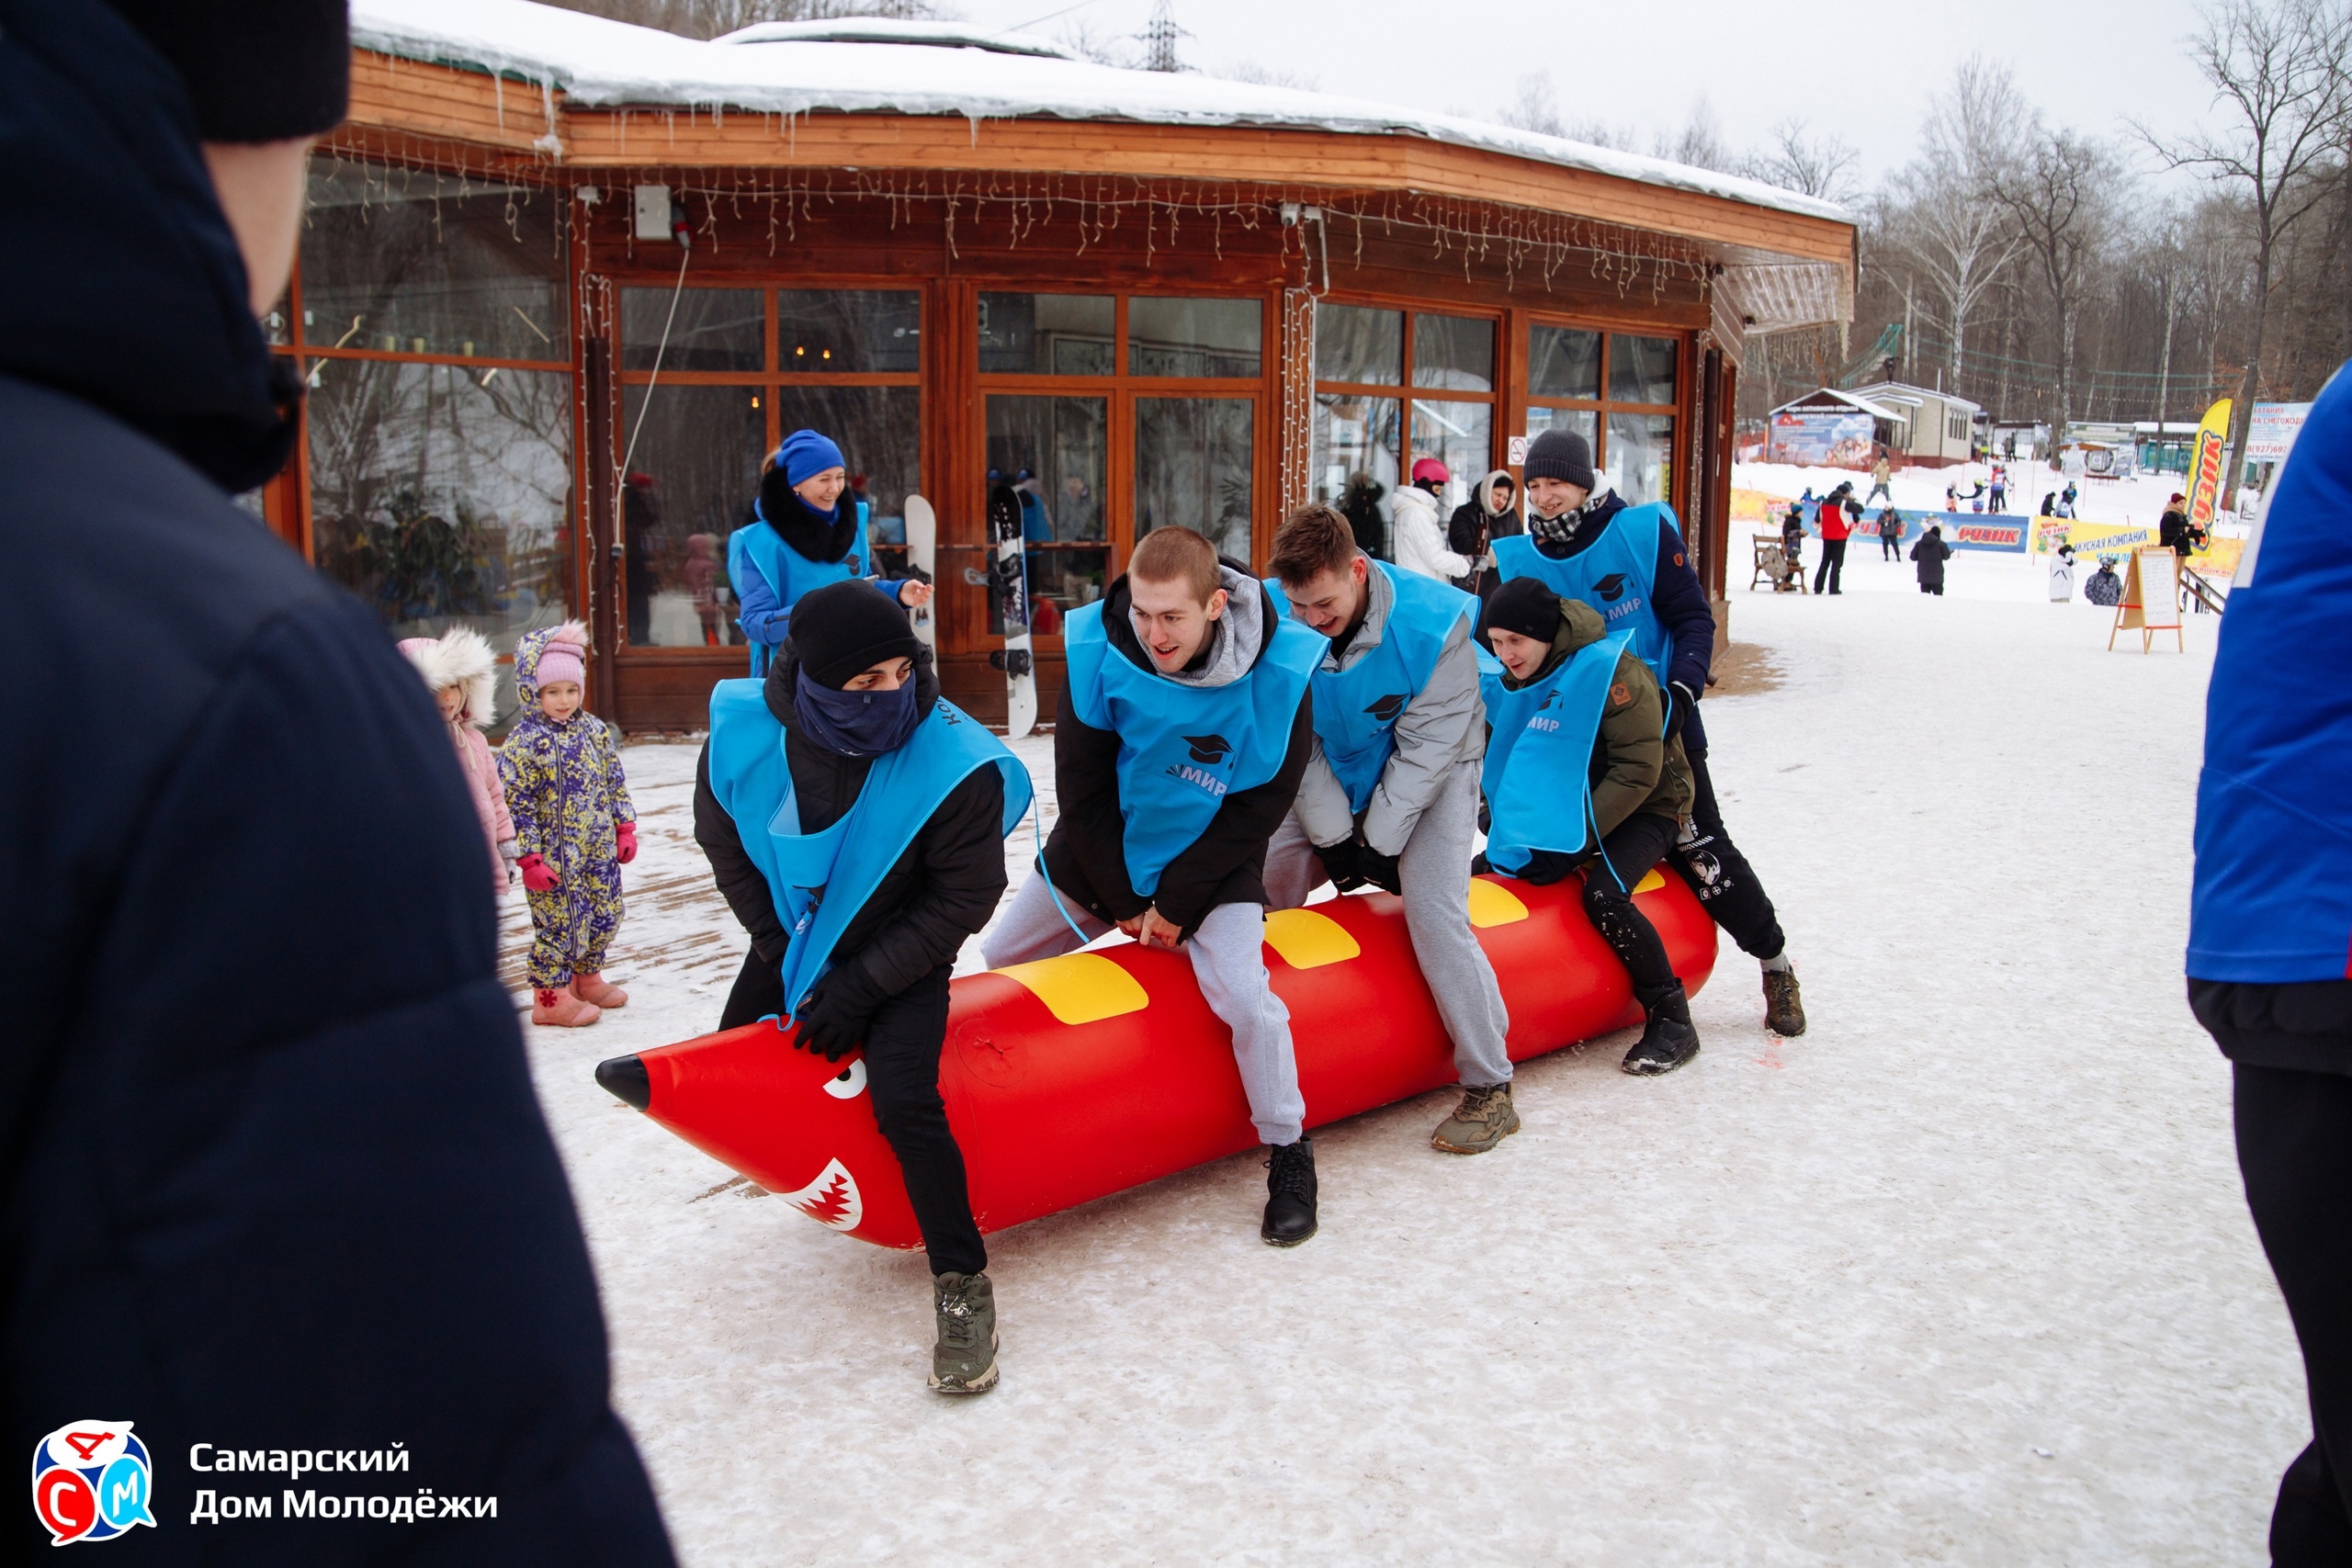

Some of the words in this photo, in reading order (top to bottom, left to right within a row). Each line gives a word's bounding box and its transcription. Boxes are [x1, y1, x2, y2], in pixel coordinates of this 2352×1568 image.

[1957, 525, 2020, 544] РУЗИК
[2074, 537, 2106, 553] ВКУСНАЯ
[2108, 529, 2148, 548] КОМПАНИЯ
[1607, 597, 1642, 622] МИР
[937, 699, 962, 726] КО
[1527, 716, 1560, 733] МИР
[1181, 765, 1227, 797] МИР
